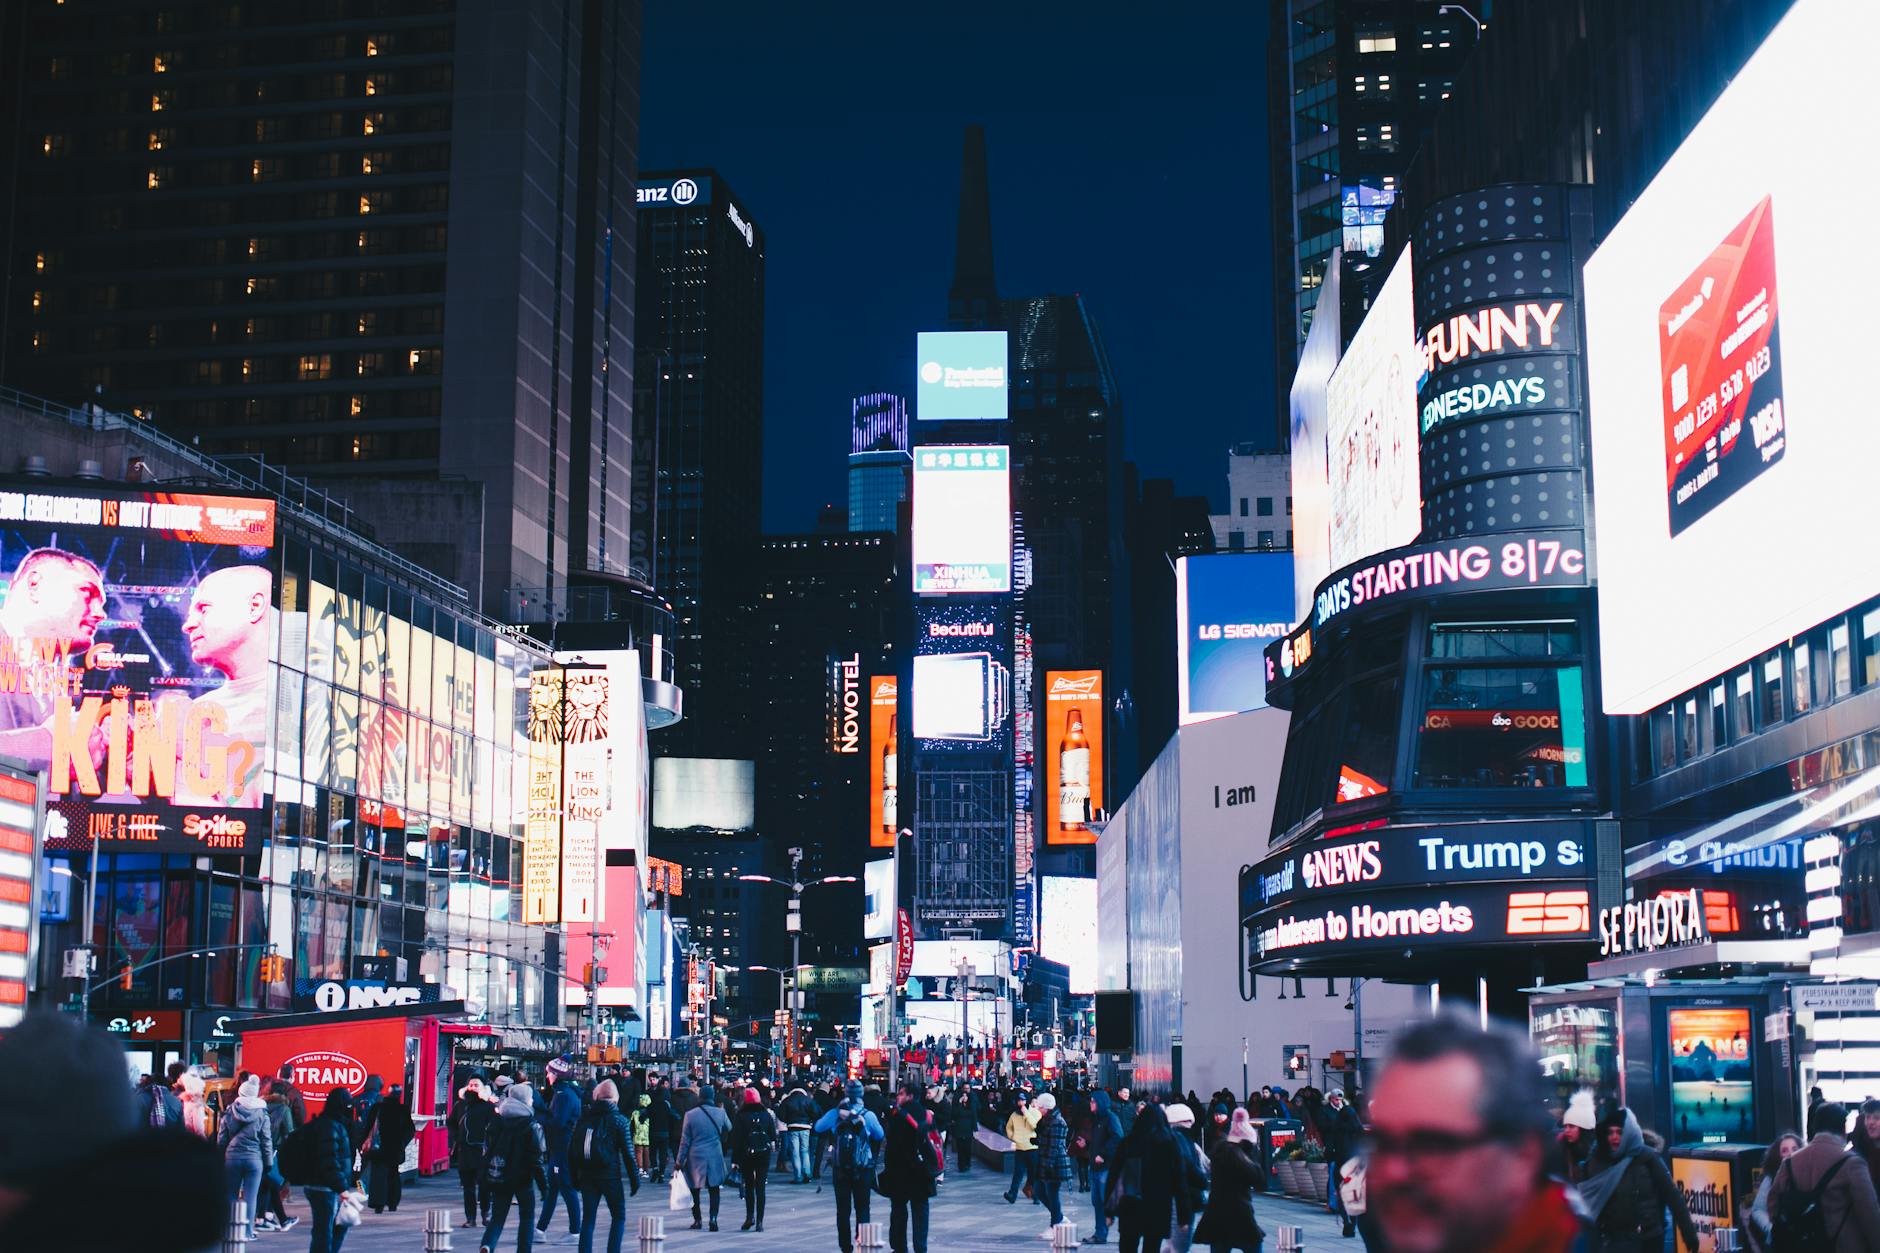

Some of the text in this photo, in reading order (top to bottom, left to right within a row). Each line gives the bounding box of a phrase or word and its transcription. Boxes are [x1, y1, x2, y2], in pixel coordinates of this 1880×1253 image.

[1427, 303, 1563, 372] FUNNY
[1696, 392, 1717, 428] 1234
[1720, 369, 1743, 408] 5678
[1746, 346, 1770, 384] 9123
[1422, 376, 1546, 434] EDNESDAYS
[1750, 398, 1783, 448] VISA
[102, 499, 118, 526] VS
[934, 565, 991, 579] XINHUA
[1352, 545, 1491, 605] STARTING
[930, 623, 994, 637] Beautiful
[1199, 624, 1221, 640] LG
[446, 674, 473, 715] THE
[842, 652, 860, 753] NOVOTEL
[1492, 713, 1512, 726] abc
[575, 771, 594, 781] THE
[570, 784, 599, 799] LION
[1214, 785, 1256, 808] I am
[568, 802, 602, 821] KING
[88, 813, 114, 839] LIVE
[130, 815, 159, 841] FREE
[183, 814, 247, 840] Spike
[207, 835, 245, 848] SPORTS
[1313, 841, 1382, 888] NEWS
[1418, 838, 1546, 874] Trump
[1326, 910, 1348, 941] to
[1351, 901, 1474, 939] Hornets
[1599, 888, 1702, 956] SEPHORA
[349, 985, 421, 1010] NYC
[1802, 988, 1874, 998] PEDESTRIAN FLOW ZONE
[1835, 999, 1850, 1007] KEEP
[304, 1055, 321, 1063] MILES
[322, 1054, 331, 1062] OF
[290, 1068, 362, 1085] TRAND
